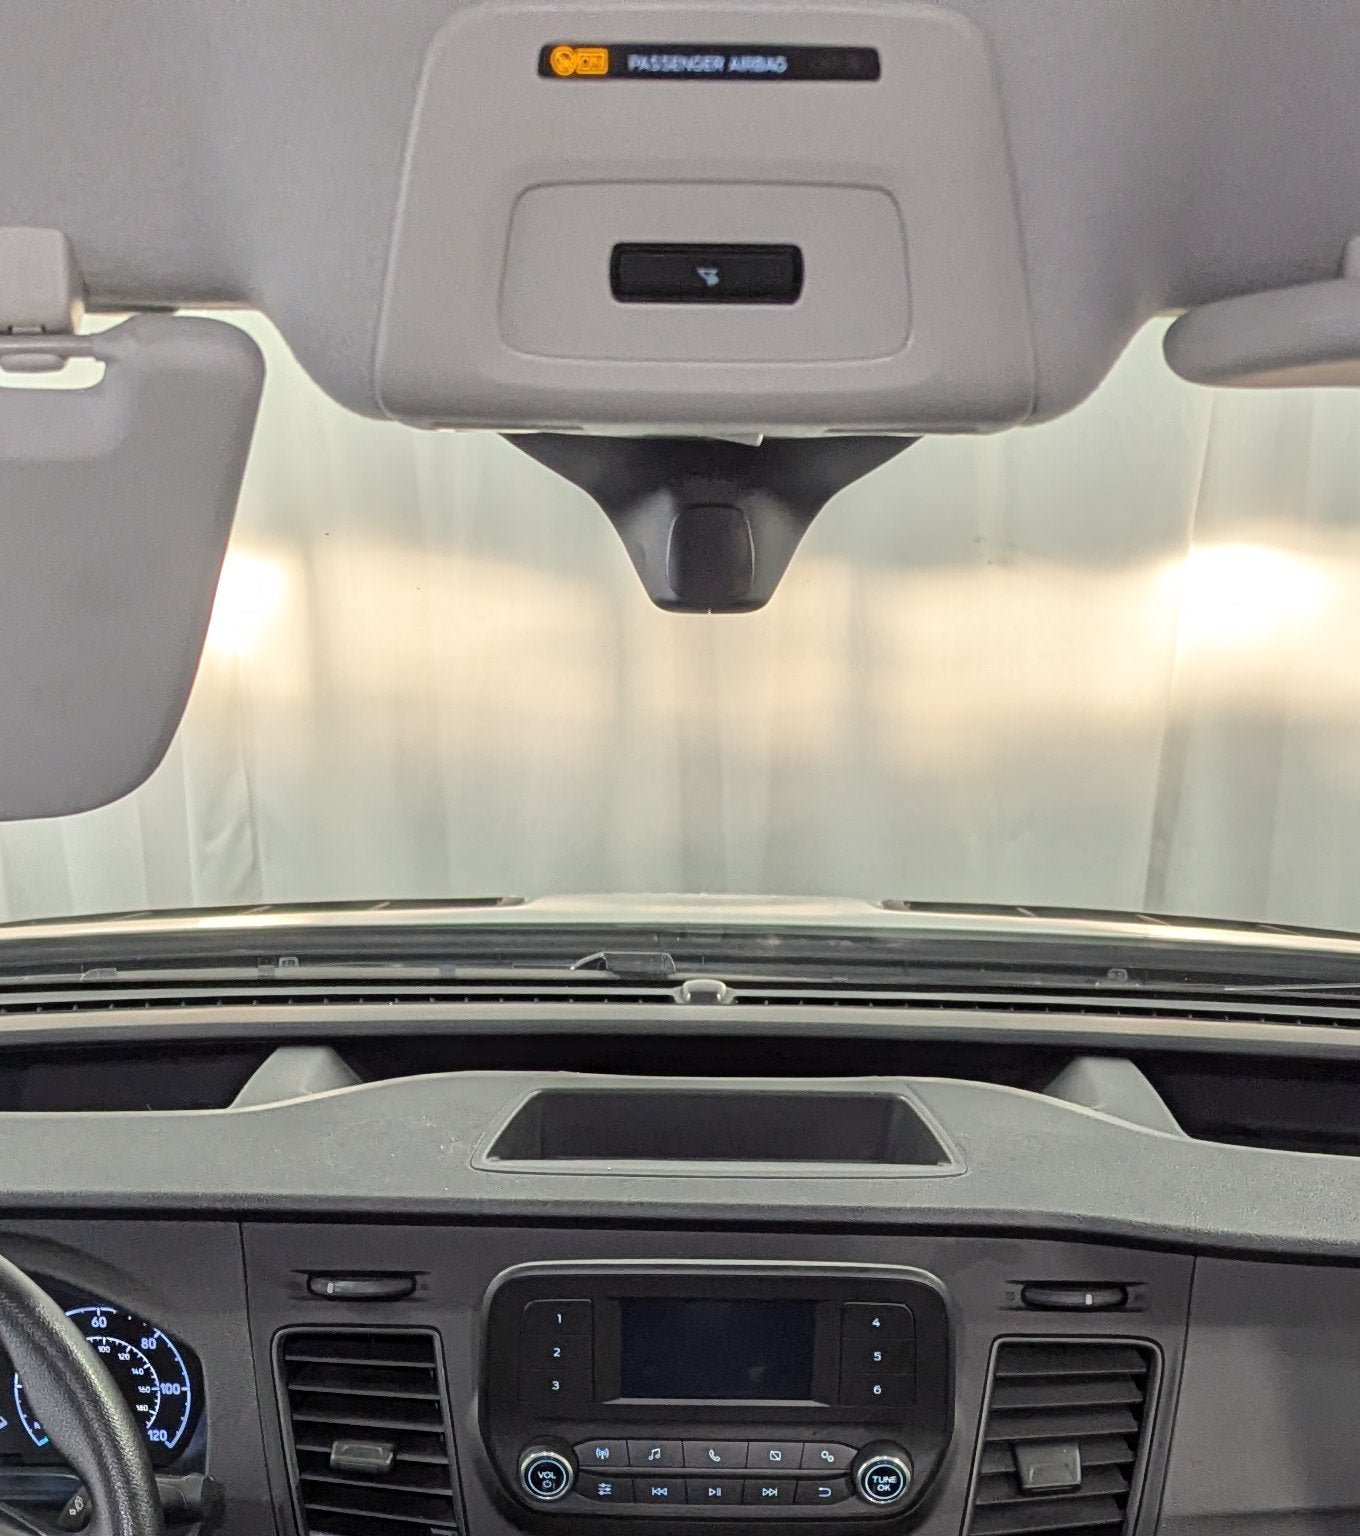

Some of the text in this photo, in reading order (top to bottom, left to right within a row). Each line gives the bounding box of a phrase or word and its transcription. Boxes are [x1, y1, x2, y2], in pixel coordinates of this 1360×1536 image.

[627, 54, 788, 73] PASSENGER AIRBAG
[90, 1314, 108, 1329] 60
[557, 1313, 562, 1324] 1
[871, 1317, 881, 1328] 4
[141, 1337, 157, 1350] 80
[553, 1347, 561, 1358] 2
[873, 1351, 882, 1362] 5
[160, 1383, 181, 1395] 100
[551, 1380, 560, 1391] 3
[873, 1384, 882, 1395] 6
[147, 1429, 168, 1442] 120
[537, 1470, 557, 1480] VOL
[871, 1475, 897, 1484] TUNE
[876, 1483, 891, 1492] OK
